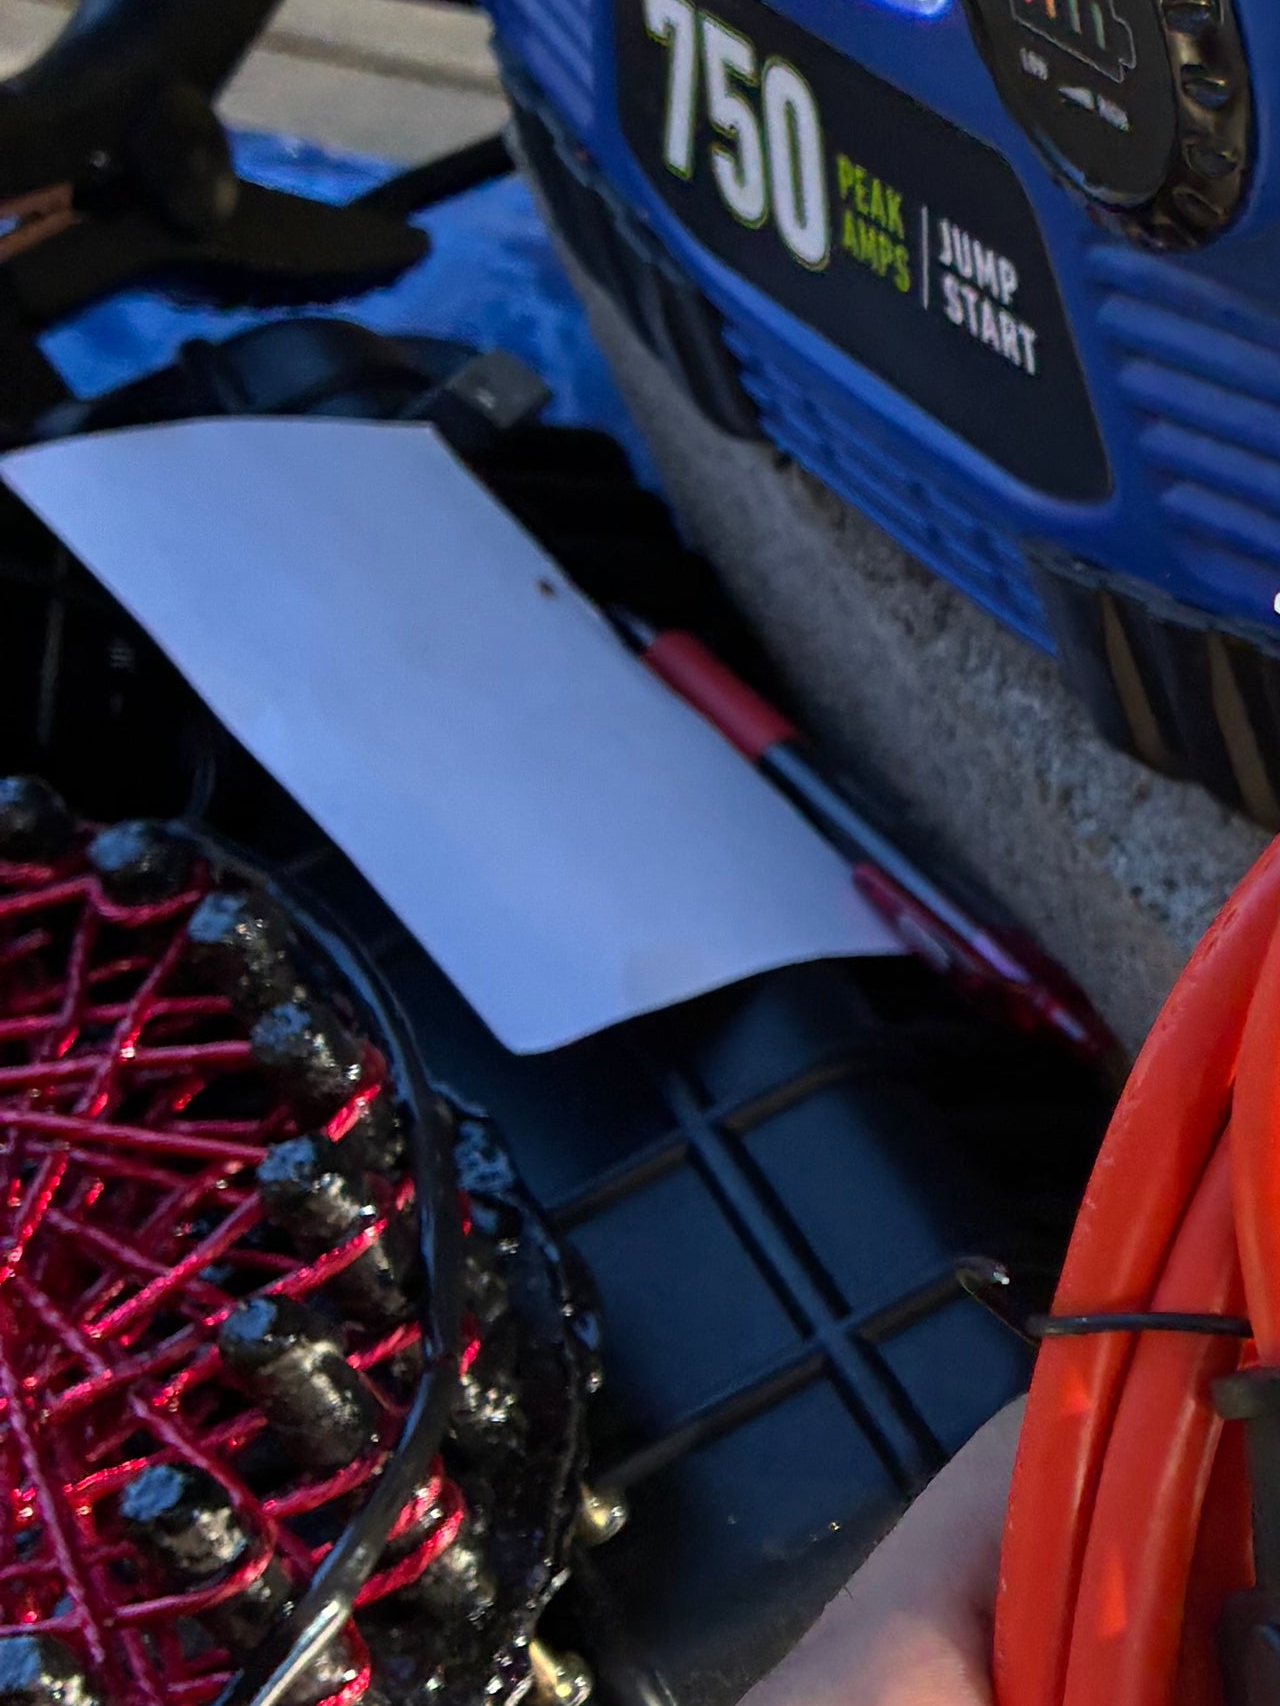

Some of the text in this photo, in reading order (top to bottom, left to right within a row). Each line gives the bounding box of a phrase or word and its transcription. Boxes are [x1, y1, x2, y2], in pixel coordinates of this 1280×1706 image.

[836, 153, 906, 240] PEAK
[840, 210, 911, 293] AMPS
[938, 217, 1018, 306] JUMP
[943, 273, 1038, 376] START
